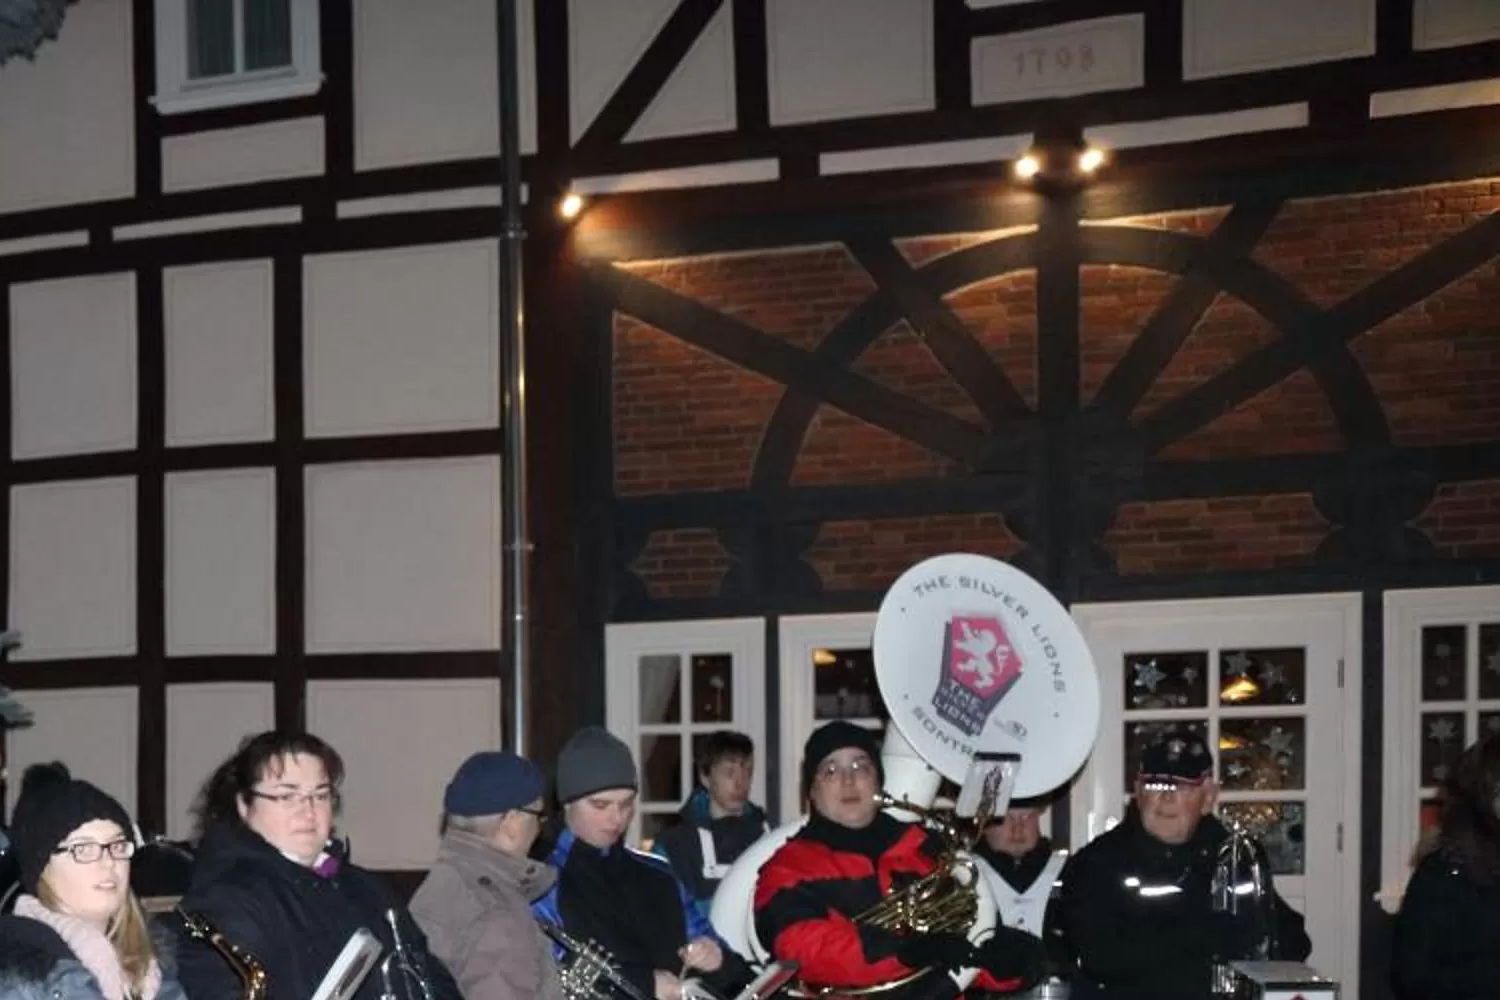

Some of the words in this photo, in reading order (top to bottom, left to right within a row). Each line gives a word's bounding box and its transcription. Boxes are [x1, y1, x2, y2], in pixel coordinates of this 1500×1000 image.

[913, 575, 951, 599] THE
[958, 575, 1029, 620] SILVER
[1031, 624, 1066, 693] LIONS
[911, 705, 978, 756] SONTR
